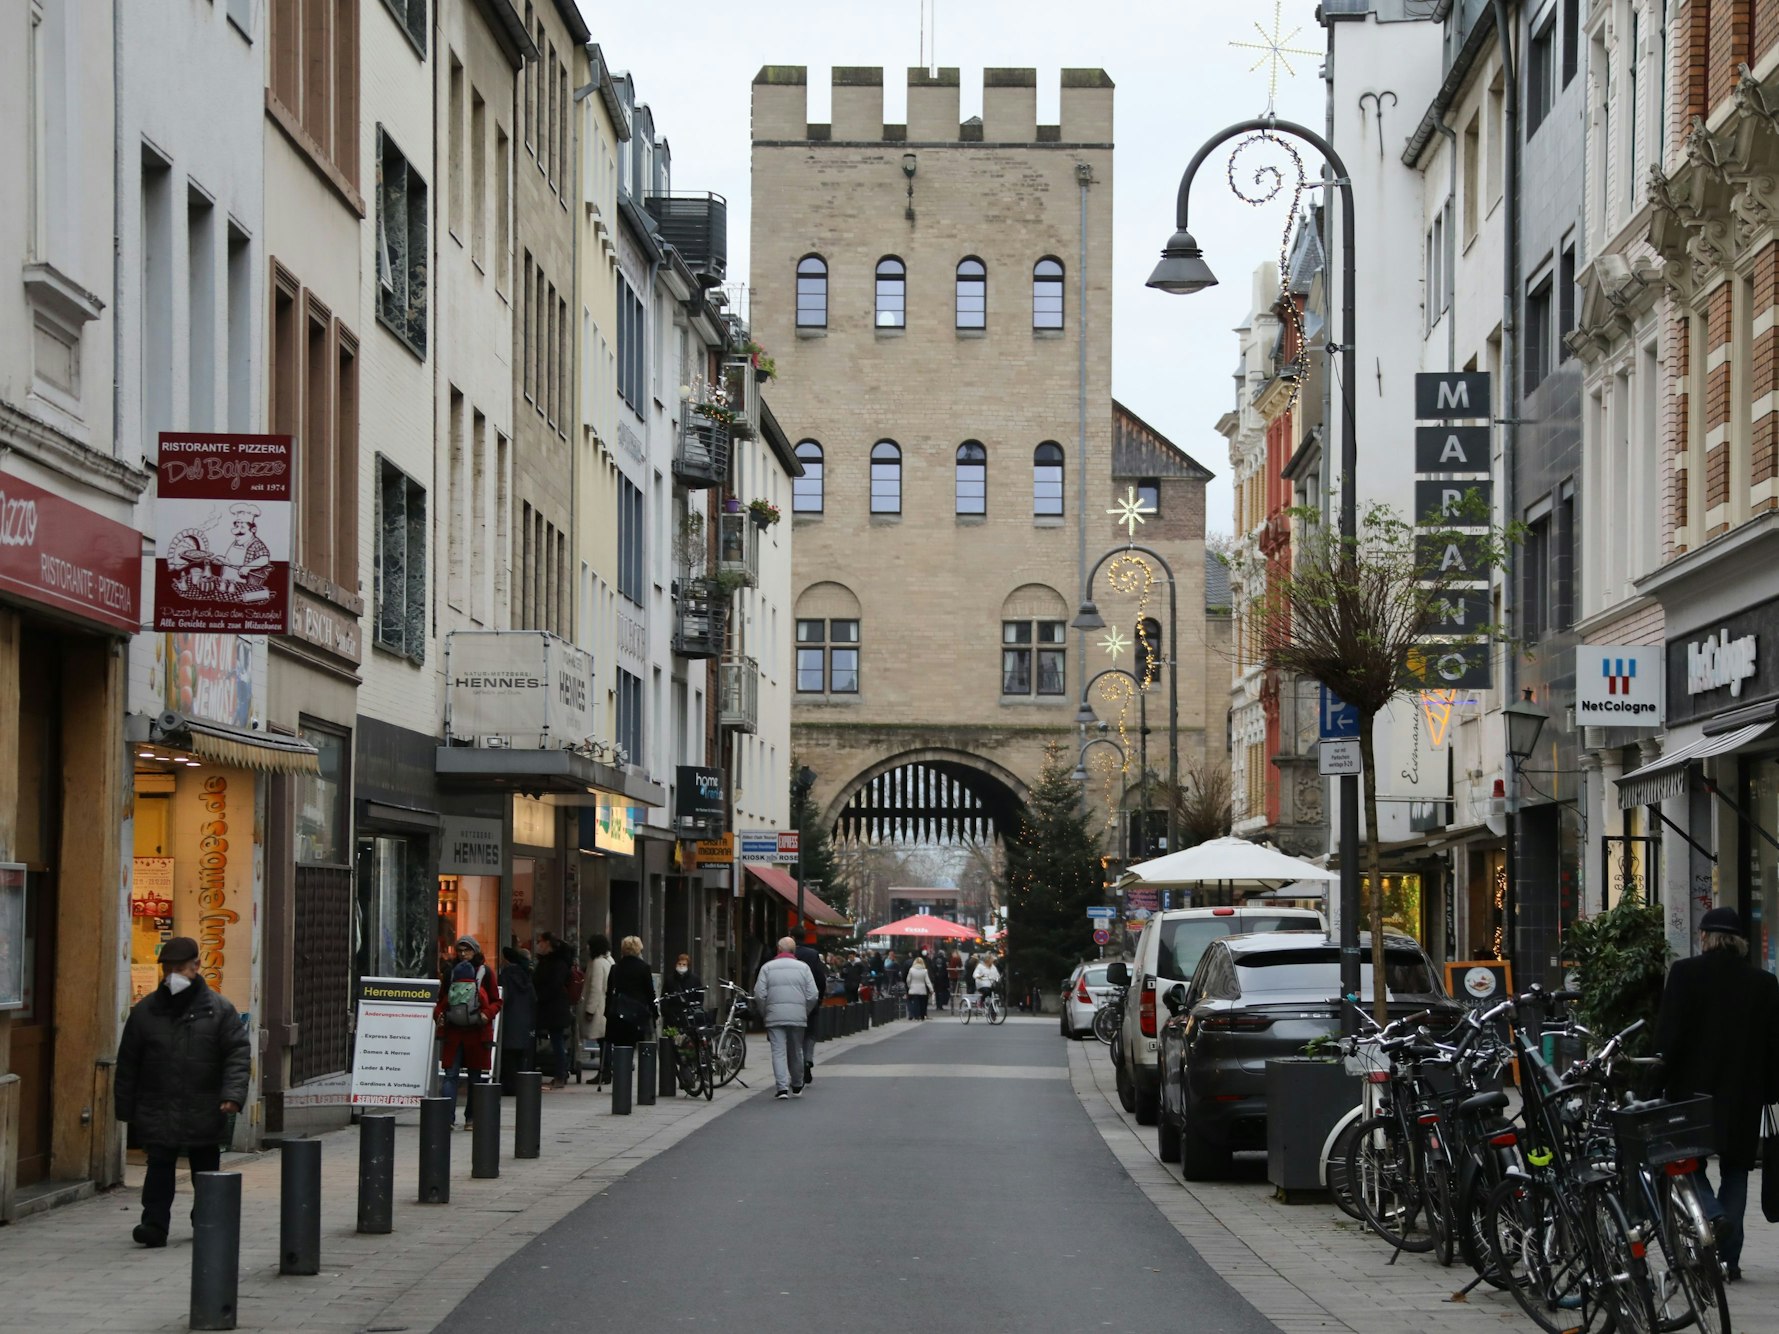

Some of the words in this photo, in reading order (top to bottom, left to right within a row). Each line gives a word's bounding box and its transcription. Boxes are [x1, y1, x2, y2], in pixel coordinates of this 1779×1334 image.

[161, 442, 231, 453] RISTORANTE
[238, 443, 287, 454] PIZZERIA
[161, 458, 204, 483] Del
[203, 457, 287, 490] Bajazzo
[266, 484, 286, 492] 1974
[1436, 380, 1470, 681] MARANO
[40, 552, 94, 600] RISTORANTE
[98, 574, 132, 613] PIZZERIA
[160, 618, 176, 628] Alle
[178, 618, 206, 629] Gerichte
[208, 620, 225, 629] auch
[305, 607, 333, 647] ESCH
[455, 678, 540, 689] HENNES
[559, 670, 585, 712] HENNES
[1326, 686, 1347, 730] P
[1581, 701, 1657, 714] NetCologne
[695, 772, 718, 787] home
[454, 842, 499, 865] HENNES
[198, 775, 240, 994] bsunjemoes.de
[364, 986, 431, 999] Herrenmode
[364, 1010, 428, 1019] Änderungsschneiderei
